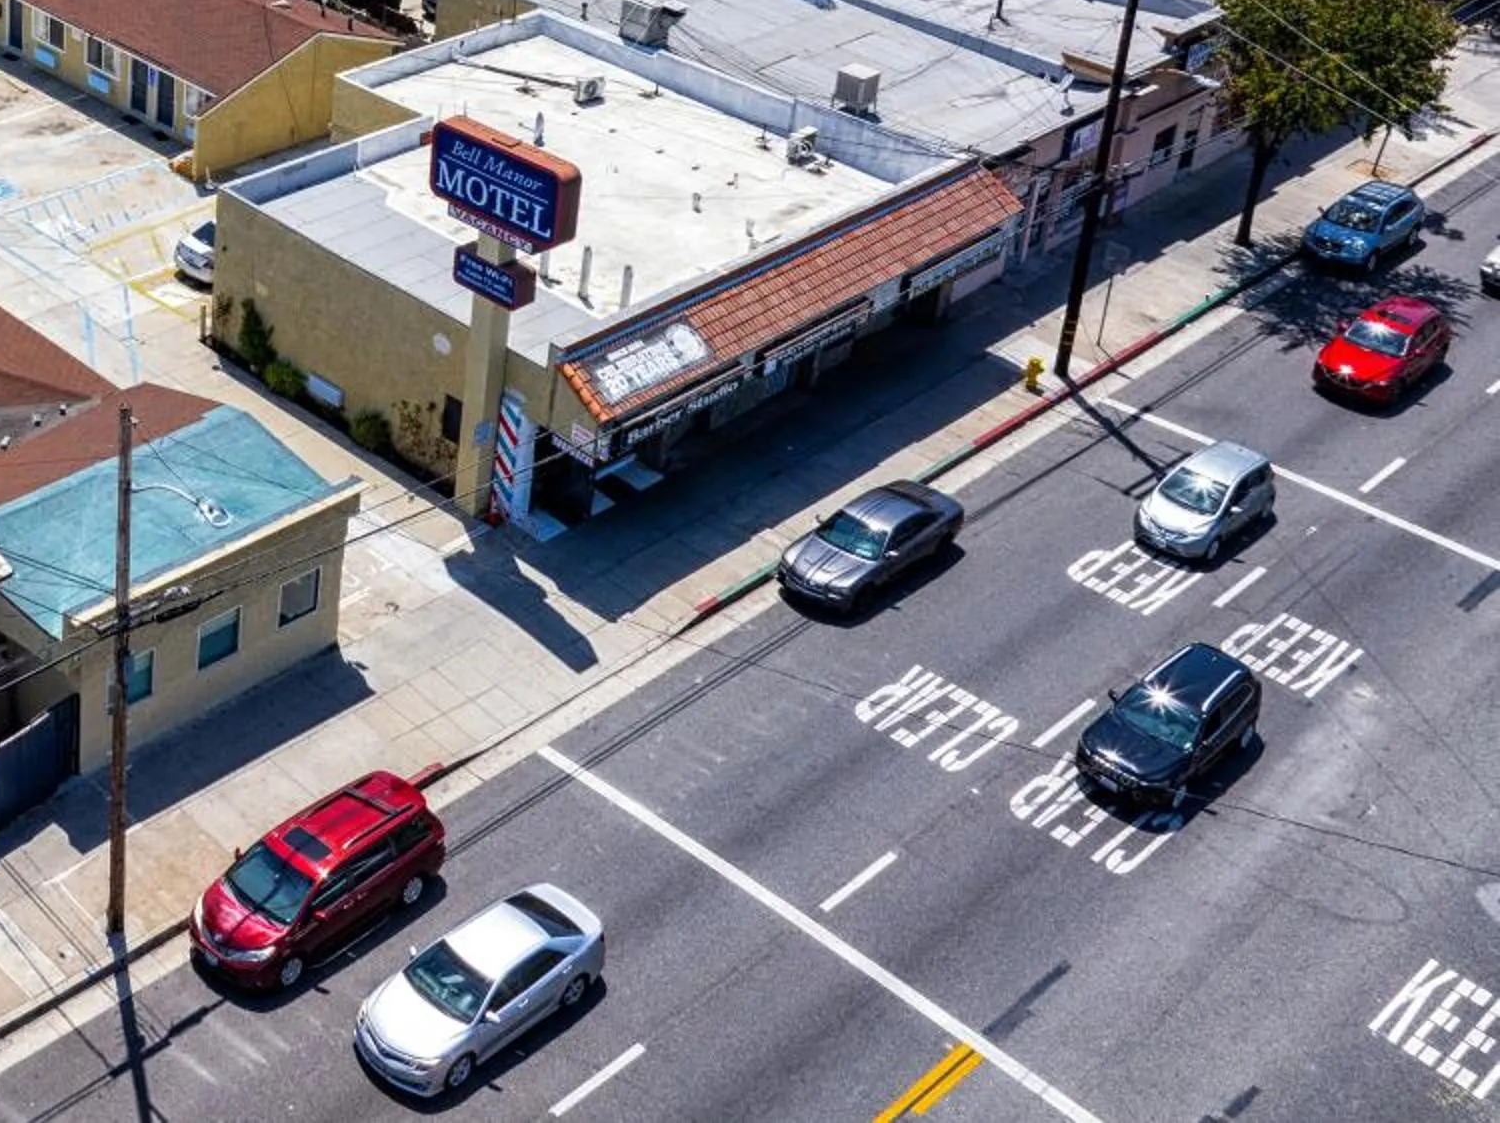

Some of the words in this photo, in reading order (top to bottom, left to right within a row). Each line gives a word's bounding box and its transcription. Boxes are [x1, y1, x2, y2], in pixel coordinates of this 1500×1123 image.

[436, 158, 551, 238] MOTEL
[452, 140, 482, 166] Bell
[483, 155, 543, 190] Manor
[1067, 539, 1204, 616] KEEP
[1220, 612, 1365, 699] KEEP
[855, 664, 1019, 773] CLEAR
